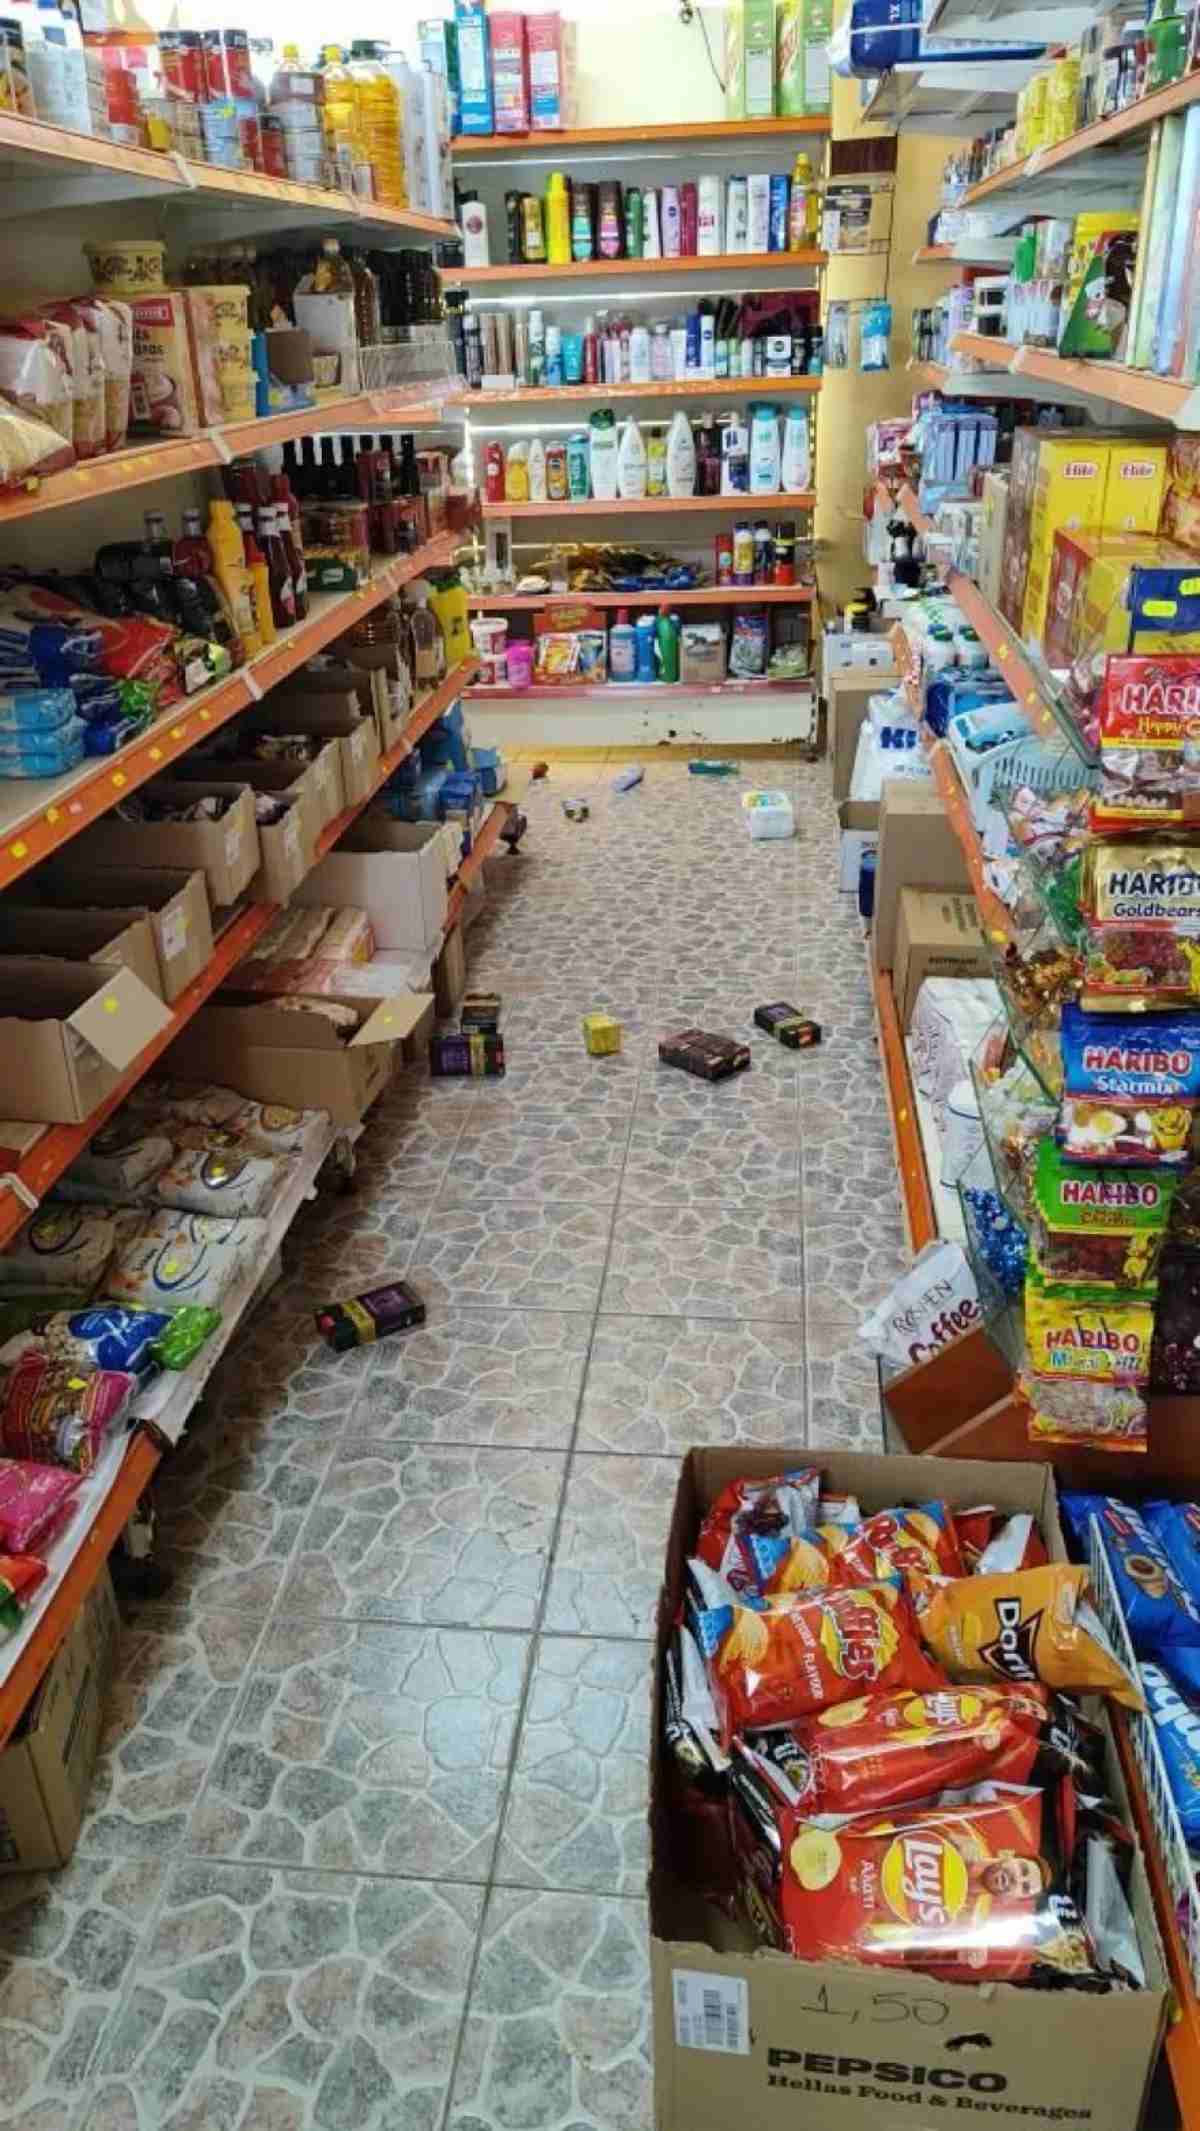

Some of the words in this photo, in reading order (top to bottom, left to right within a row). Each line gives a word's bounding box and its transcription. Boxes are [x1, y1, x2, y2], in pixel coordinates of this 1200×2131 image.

[1083, 1046, 1191, 1077] HARIBO
[1062, 1181, 1160, 1208] HARIBO
[801, 1983, 950, 2026] 1,50
[767, 2047, 1007, 2093] PEPSICO
[767, 2074, 852, 2097] Hellas
[857, 2084, 922, 2108] Food
[929, 2091, 948, 2108] &
[955, 2097, 1093, 2121] Beverages
